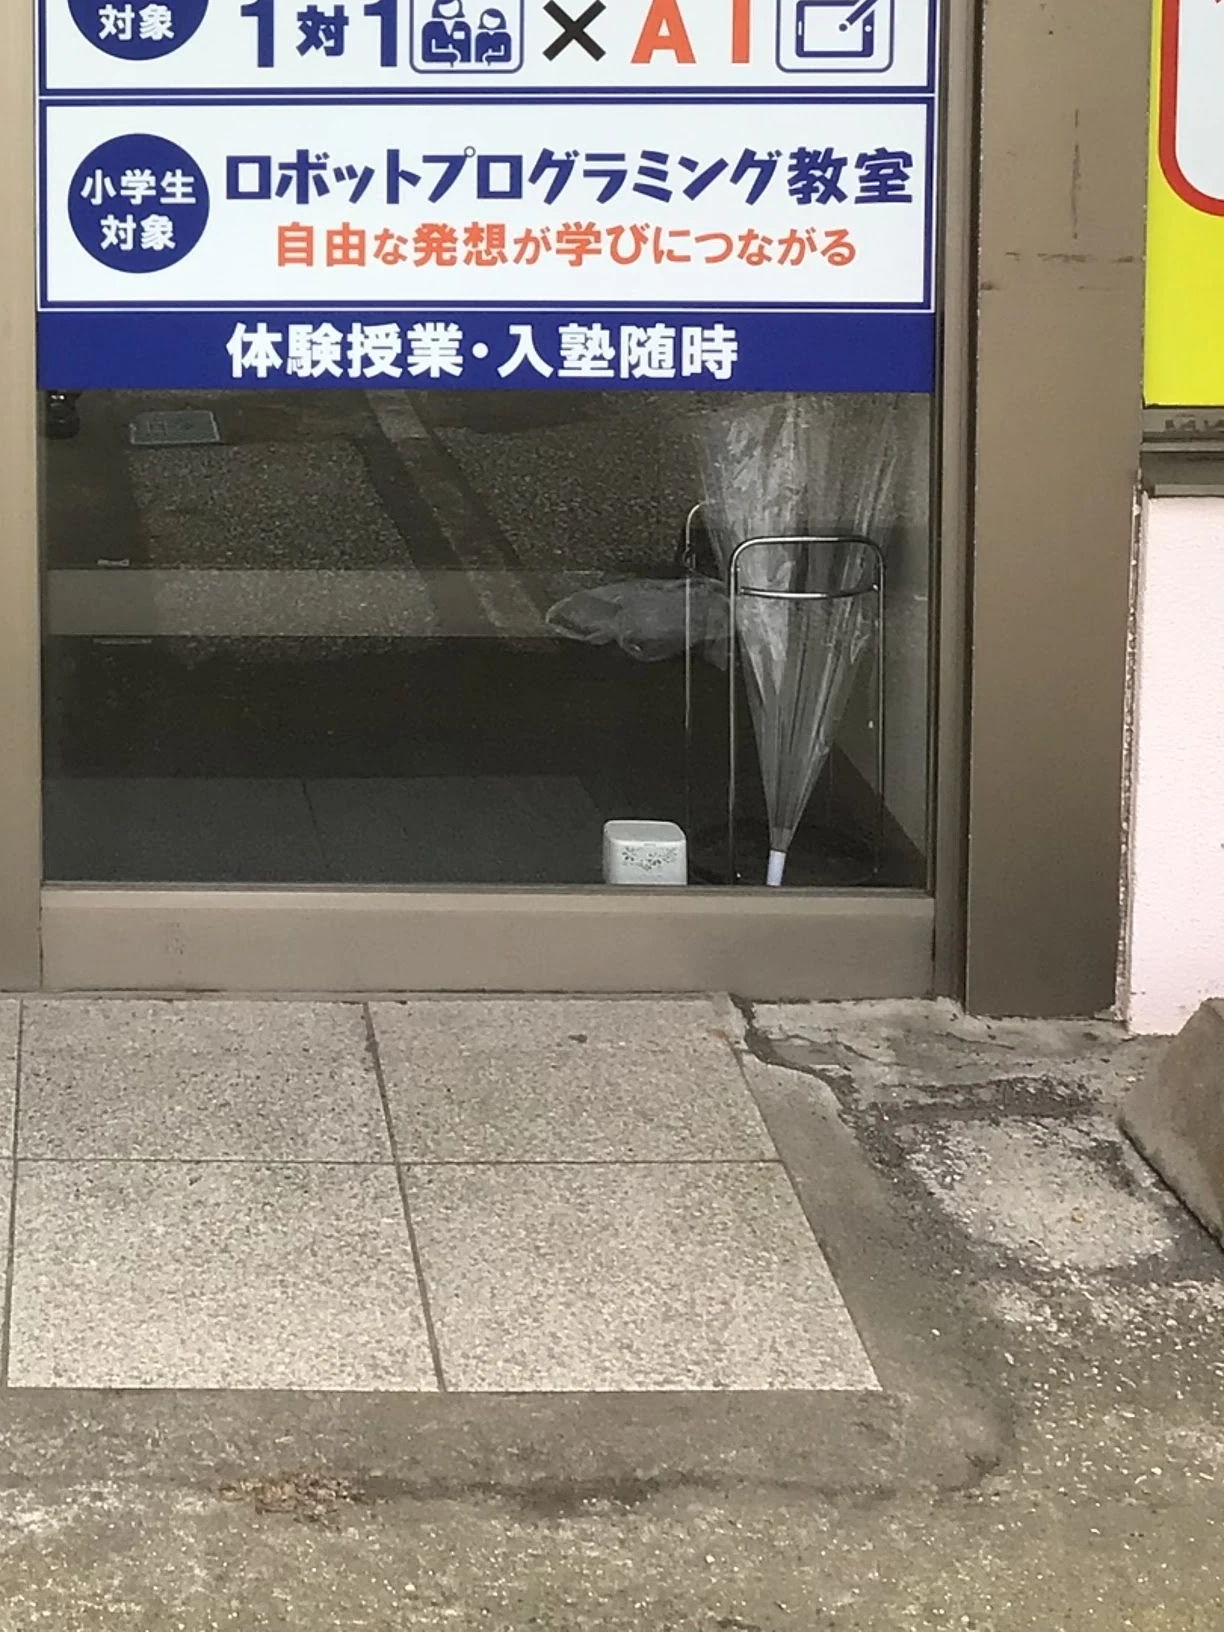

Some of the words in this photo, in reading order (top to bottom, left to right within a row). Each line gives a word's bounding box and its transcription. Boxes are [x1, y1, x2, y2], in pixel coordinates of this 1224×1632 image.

[98, 4, 175, 42] 対象
[80, 169, 196, 206] 小学生
[225, 145, 916, 208] ロボットプログラミング教室
[99, 214, 176, 252] 対象
[275, 219, 857, 268] 自由な発想が学びにつながる
[226, 322, 740, 381] 体験授業・入塾随時
